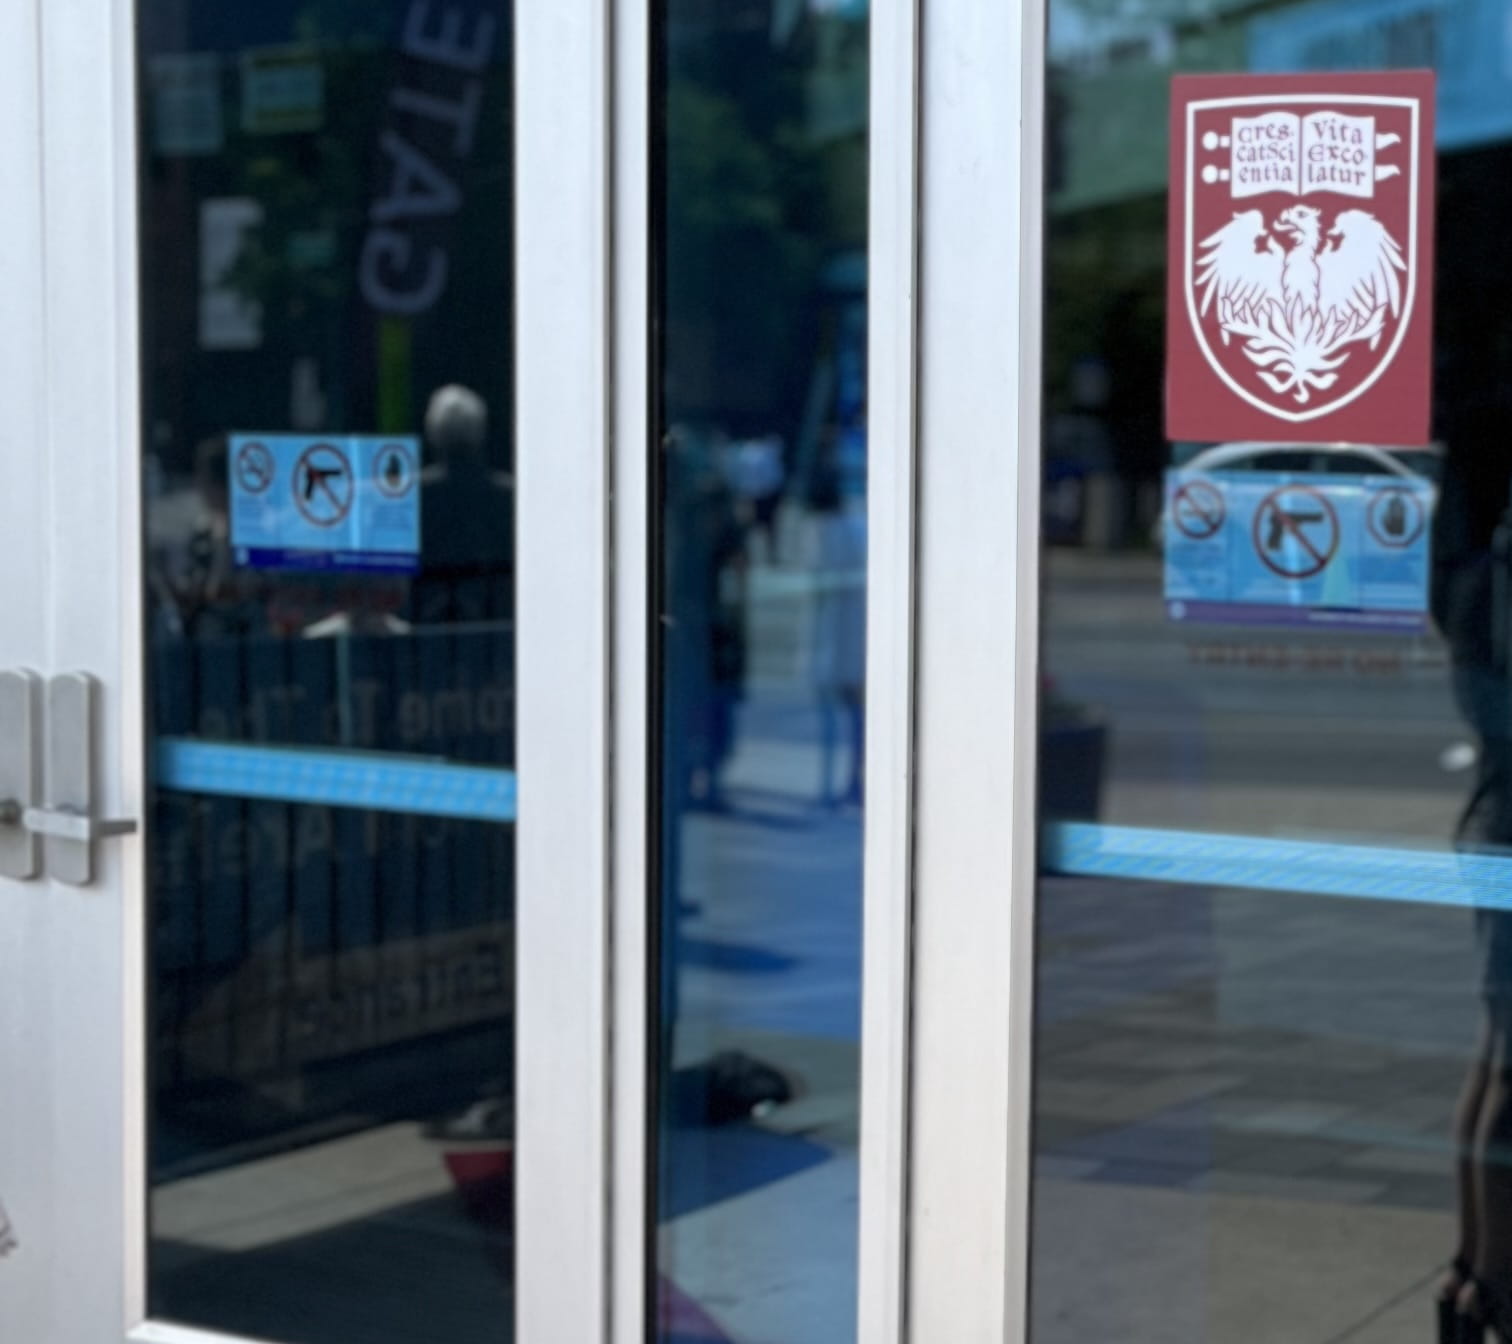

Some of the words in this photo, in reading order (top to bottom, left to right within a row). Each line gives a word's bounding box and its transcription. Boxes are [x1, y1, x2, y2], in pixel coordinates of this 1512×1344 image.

[1312, 118, 1363, 145] Vita
[1239, 163, 1293, 183] entia
[1308, 164, 1366, 186] latur
